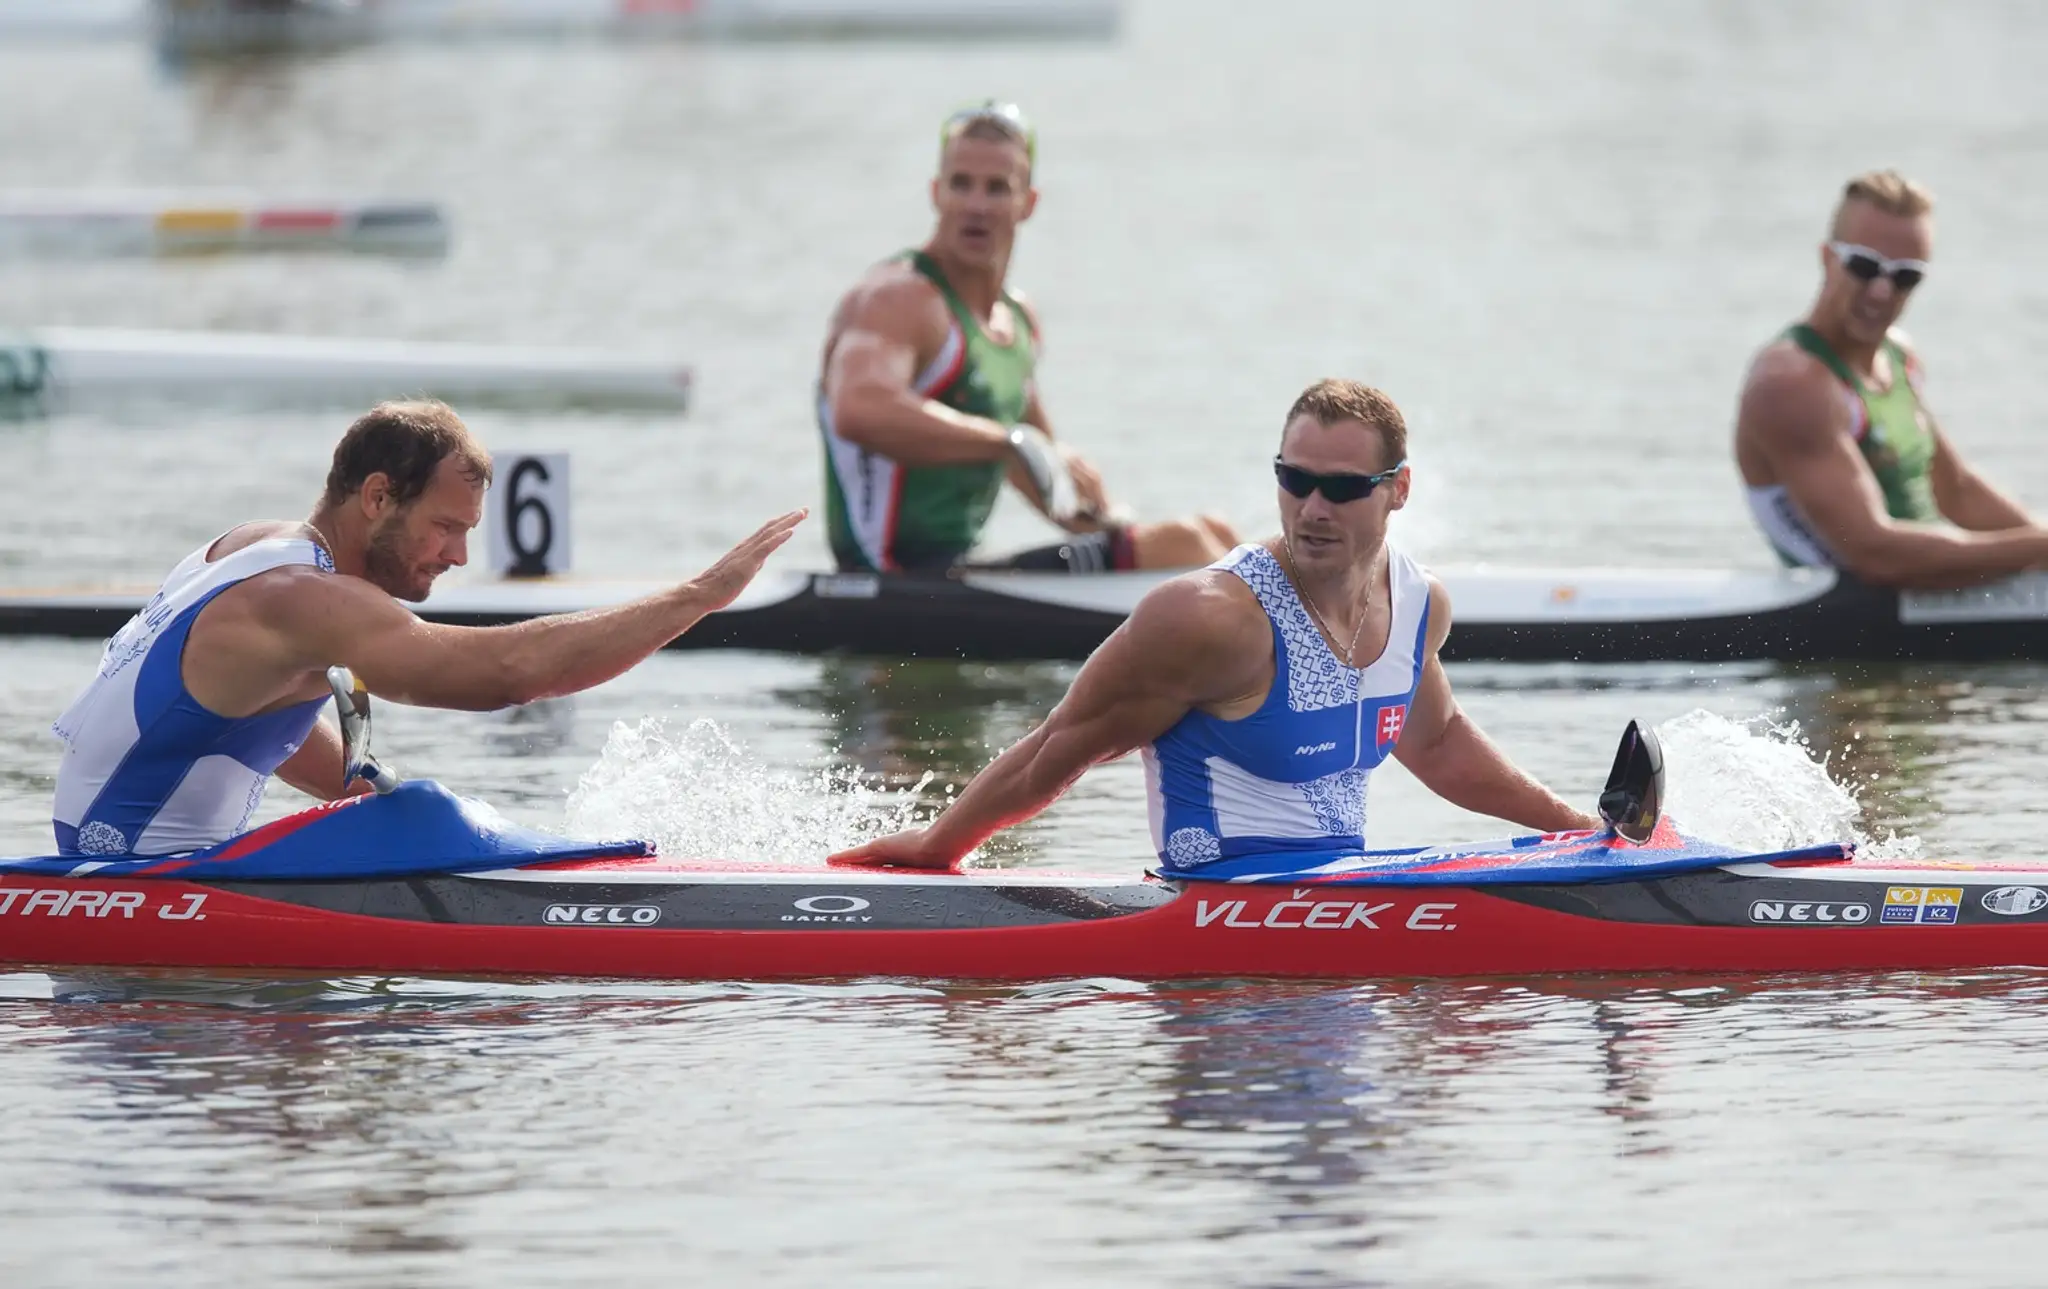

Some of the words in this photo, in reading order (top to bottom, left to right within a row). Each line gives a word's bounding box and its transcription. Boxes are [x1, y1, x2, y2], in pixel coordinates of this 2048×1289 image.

[505, 457, 553, 557] 6
[1294, 741, 1337, 756] NyNa
[158, 893, 208, 921] J.
[547, 906, 659, 924] NELO
[1195, 888, 1395, 929] VLČEK
[1405, 903, 1458, 930] E.
[1753, 902, 1868, 921] NELO
[1930, 908, 1948, 918] K2
[780, 914, 872, 923] OAKLEY
